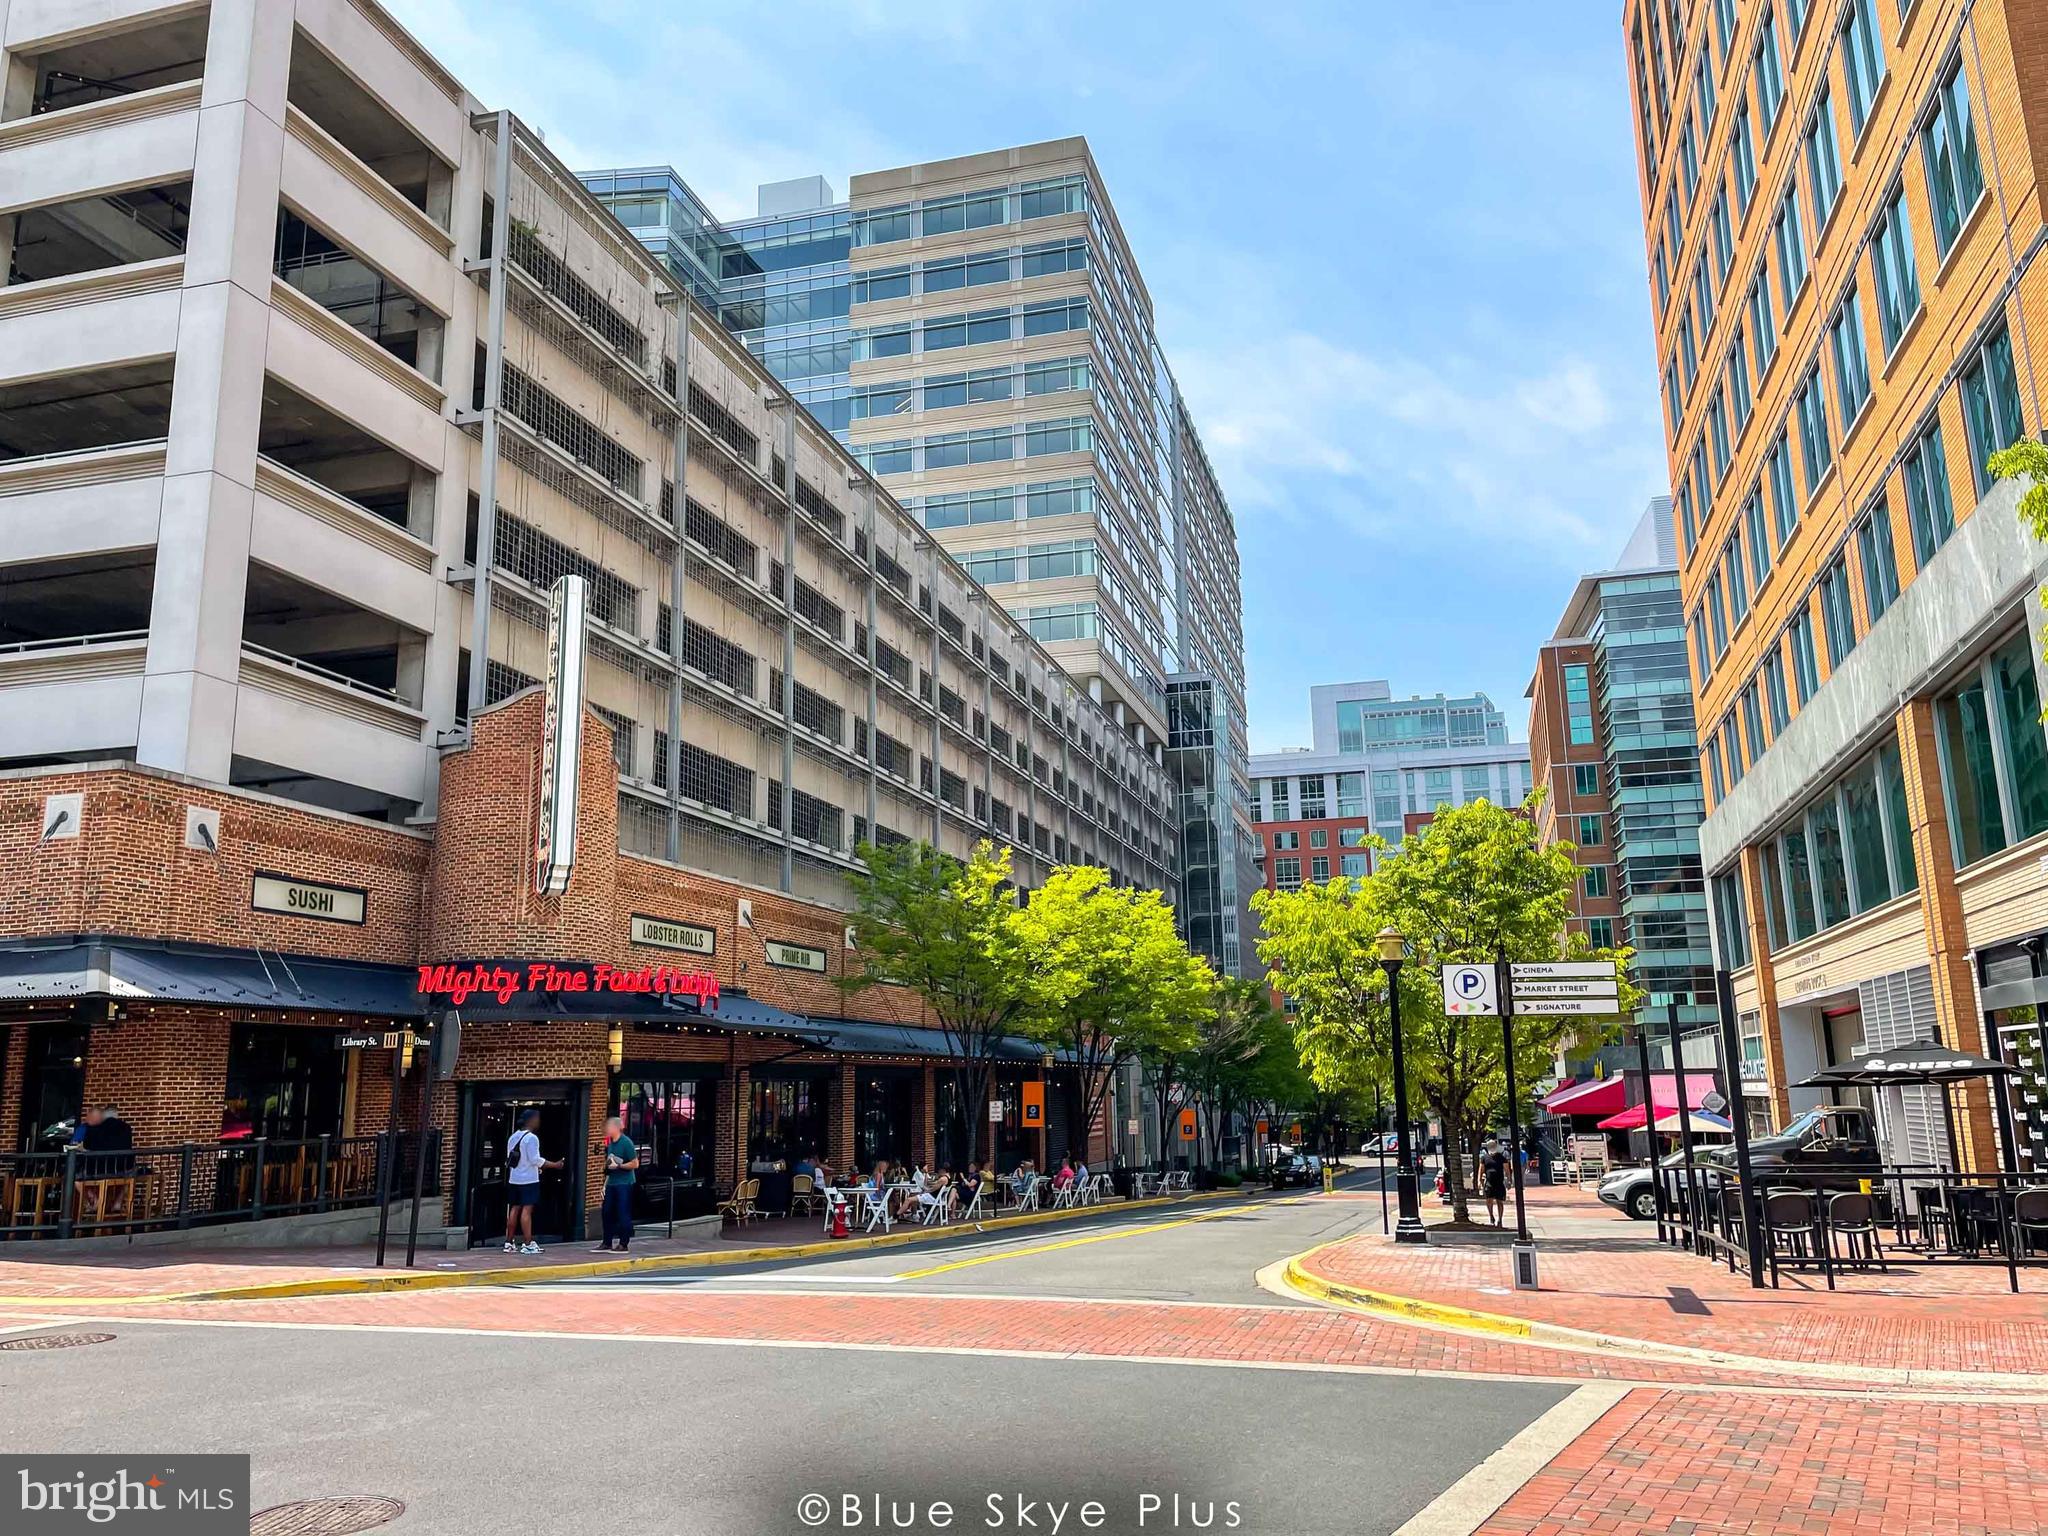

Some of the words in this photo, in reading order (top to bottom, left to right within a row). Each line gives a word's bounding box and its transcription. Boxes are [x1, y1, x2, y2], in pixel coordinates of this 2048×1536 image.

[288, 887, 334, 912] SUSHI
[642, 923, 678, 944] LOBSTER
[679, 930, 704, 949] ROLLS
[781, 949, 800, 963] PRIME
[417, 964, 519, 1005] Mighty
[527, 963, 588, 992] Fine
[593, 964, 652, 993] Food
[653, 965, 667, 993] &
[1463, 974, 1479, 994] P
[1524, 985, 1557, 993] MARKET
[341, 1037, 368, 1048] Library
[368, 1036, 378, 1046] St.
